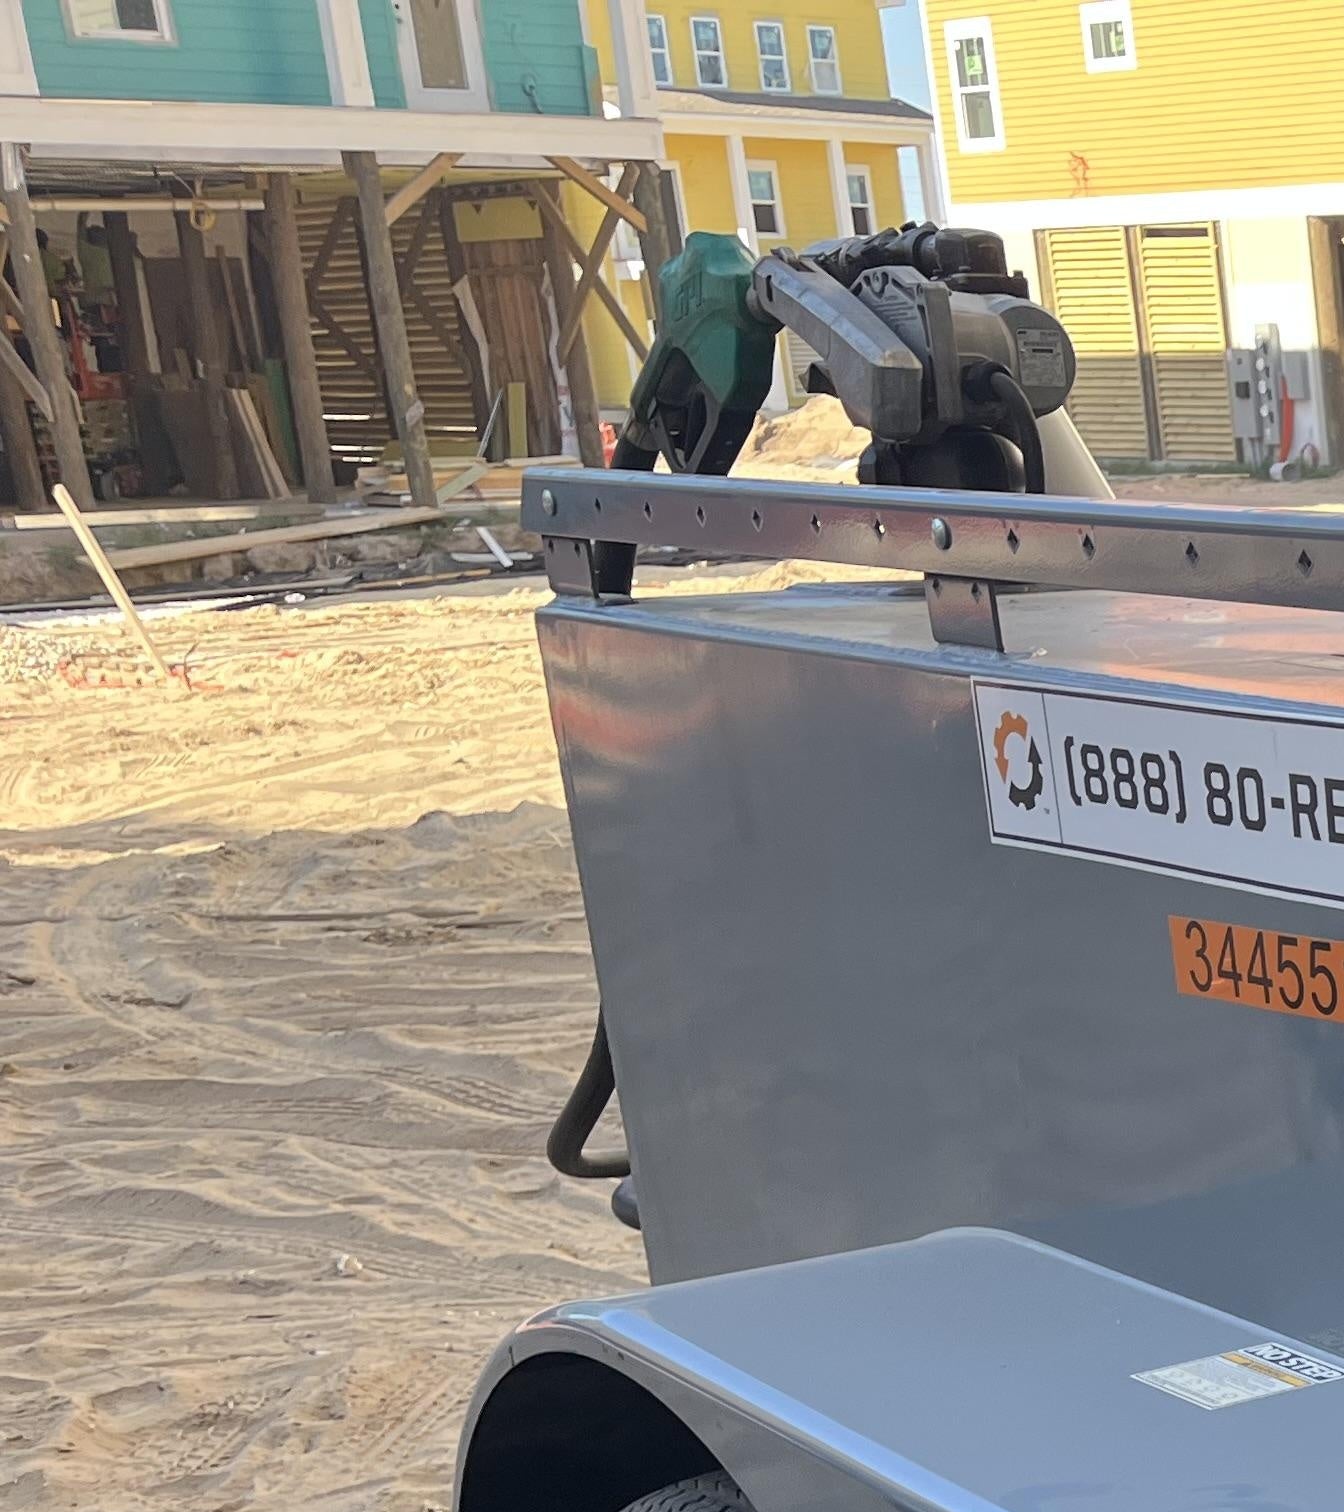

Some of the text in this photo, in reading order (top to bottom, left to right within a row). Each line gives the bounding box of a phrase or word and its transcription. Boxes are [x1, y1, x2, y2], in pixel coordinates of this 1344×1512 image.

[1064, 735, 1187, 824] (888)
[1248, 1345, 1291, 1361] NO
[1278, 1357, 1342, 1379] STEP
